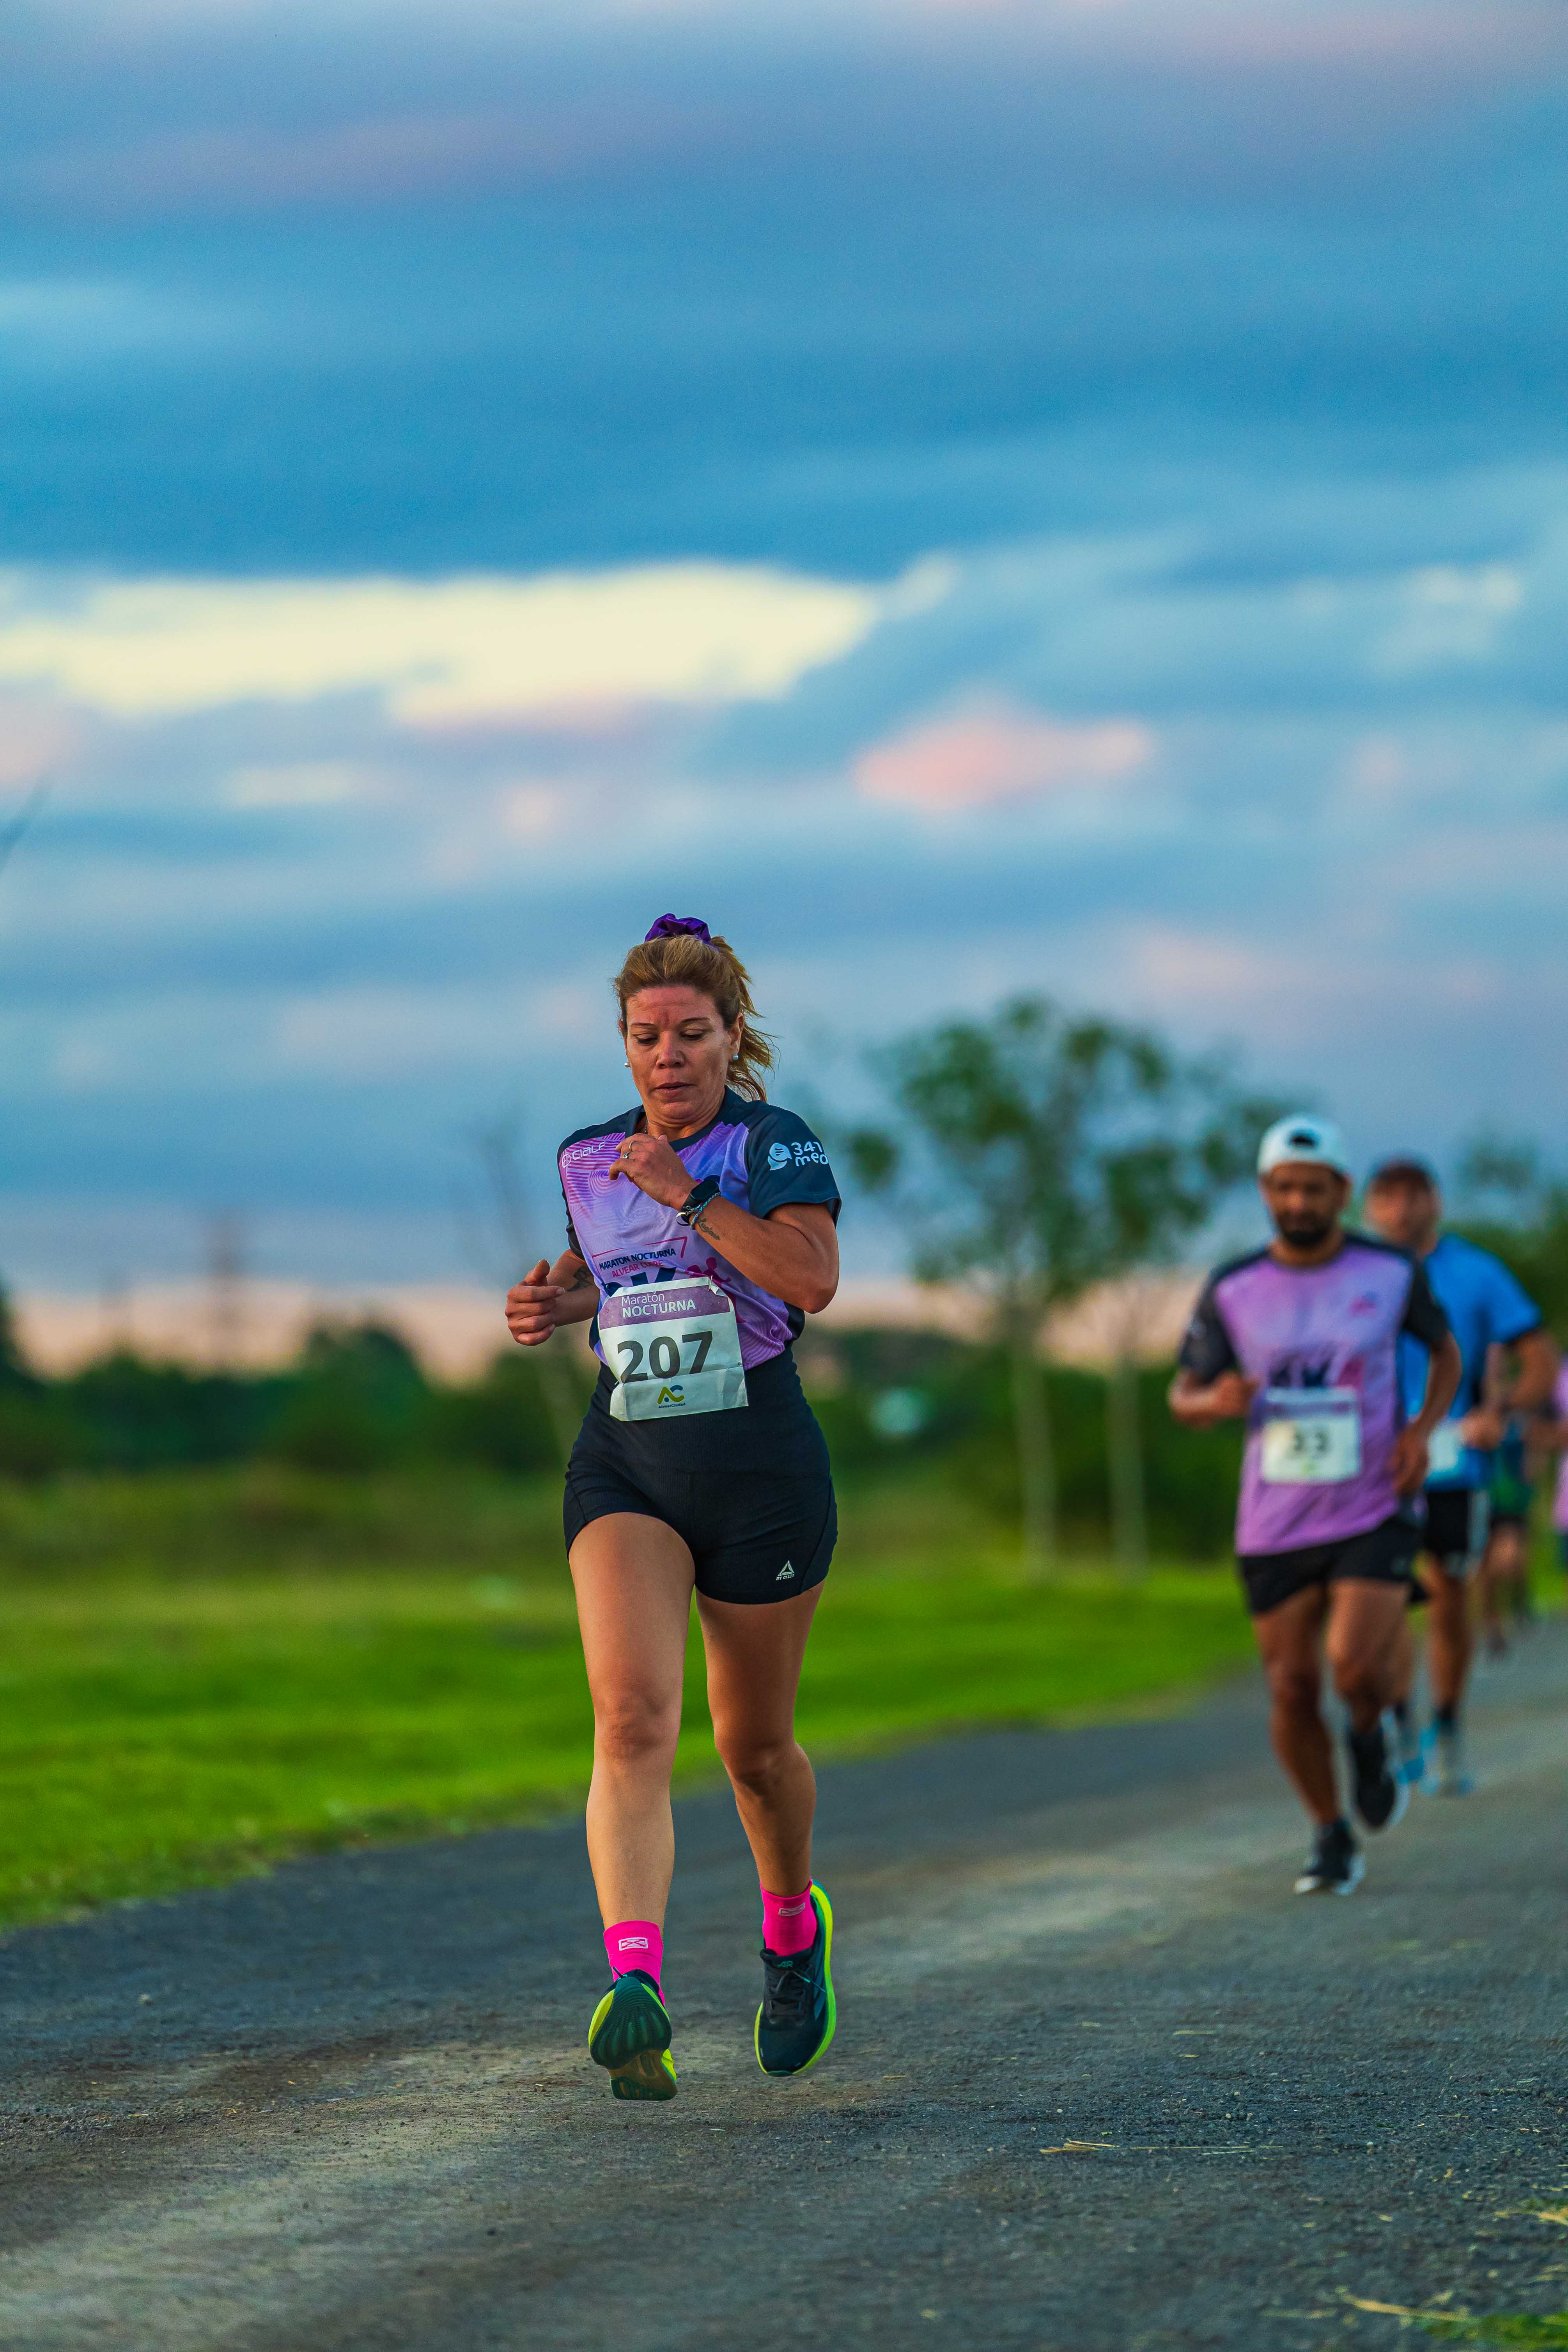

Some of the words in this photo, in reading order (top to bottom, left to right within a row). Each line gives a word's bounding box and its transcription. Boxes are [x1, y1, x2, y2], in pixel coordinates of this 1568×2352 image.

[599, 1256, 631, 1271] MARATON
[631, 1248, 676, 1261] NOCTURNA
[612, 1263, 640, 1277] ALVEAR
[622, 1291, 665, 1306] Maratón
[622, 1299, 696, 1318] NOCTURNA
[617, 1330, 713, 1384] 207
